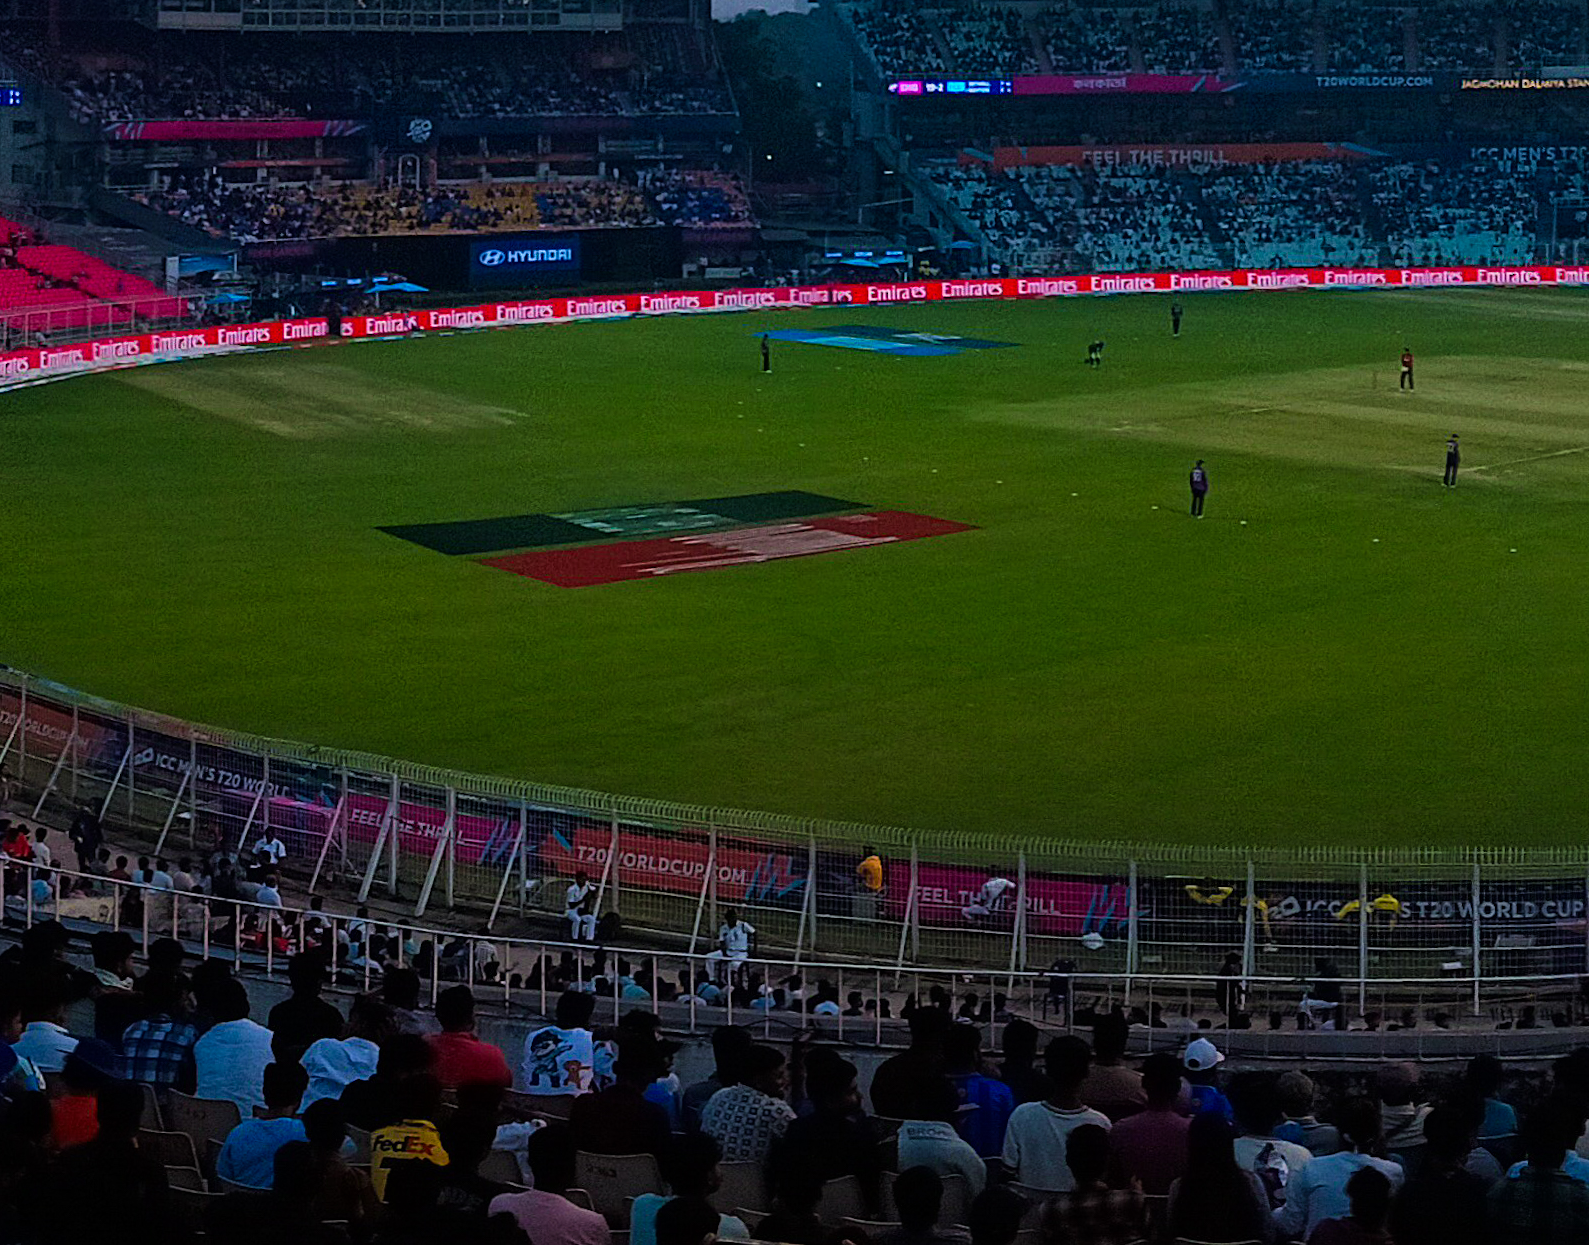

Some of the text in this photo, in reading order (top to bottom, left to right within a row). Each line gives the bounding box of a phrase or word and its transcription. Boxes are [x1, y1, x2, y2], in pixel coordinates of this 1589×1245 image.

[1316, 77, 1434, 87] T20WORLDCUP.COM
[1462, 79, 1519, 89] JAGMOHAN
[1504, 147, 1556, 161] MEN'S
[508, 249, 572, 262] HYUNDAI
[1090, 275, 1155, 292] Emirates
[1170, 273, 1232, 291] Emirates
[1247, 271, 1310, 287] Emirates
[1324, 270, 1386, 285] Emirates
[1401, 269, 1463, 284] Emirates
[1477, 269, 1541, 284] Emirates
[868, 285, 927, 303] Emirates
[942, 281, 1002, 299] Emirates
[1018, 278, 1077, 295] Emirates
[640, 295, 700, 313] Emirates
[714, 291, 775, 309] Emirates
[790, 287, 852, 305] Emirates
[496, 302, 553, 321] Emirates
[566, 299, 626, 317] Emirates
[430, 309, 484, 329] Emirates
[150, 333, 206, 353] Emirates
[218, 327, 270, 345] Emirates
[40, 349, 83, 369] Emirates
[92, 340, 140, 360] Emirates
[155, 753, 177, 770] ICC
[178, 760, 216, 781] MN'S
[218, 767, 241, 788] T20
[958, 890, 984, 907] TH
[1416, 901, 1452, 917] T20
[1457, 901, 1538, 919] WORLD
[1540, 900, 1584, 917] CUP
